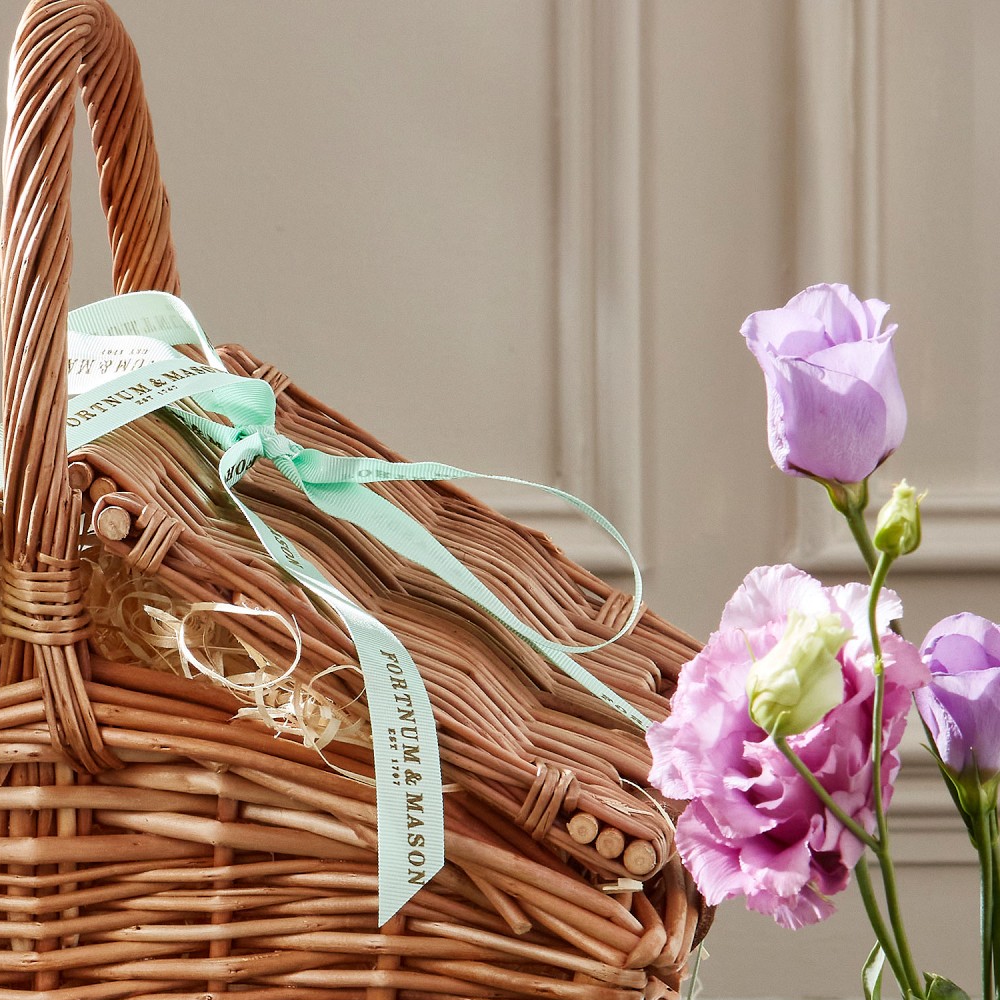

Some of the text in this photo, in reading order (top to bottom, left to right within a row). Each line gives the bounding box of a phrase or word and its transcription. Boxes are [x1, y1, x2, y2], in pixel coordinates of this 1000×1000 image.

[66, 383, 152, 428] ORTNUM
[149, 377, 167, 387] &
[162, 365, 224, 382] MASO
[380, 649, 426, 886] FORTNUM & MASON
[388, 727, 398, 750] EST
